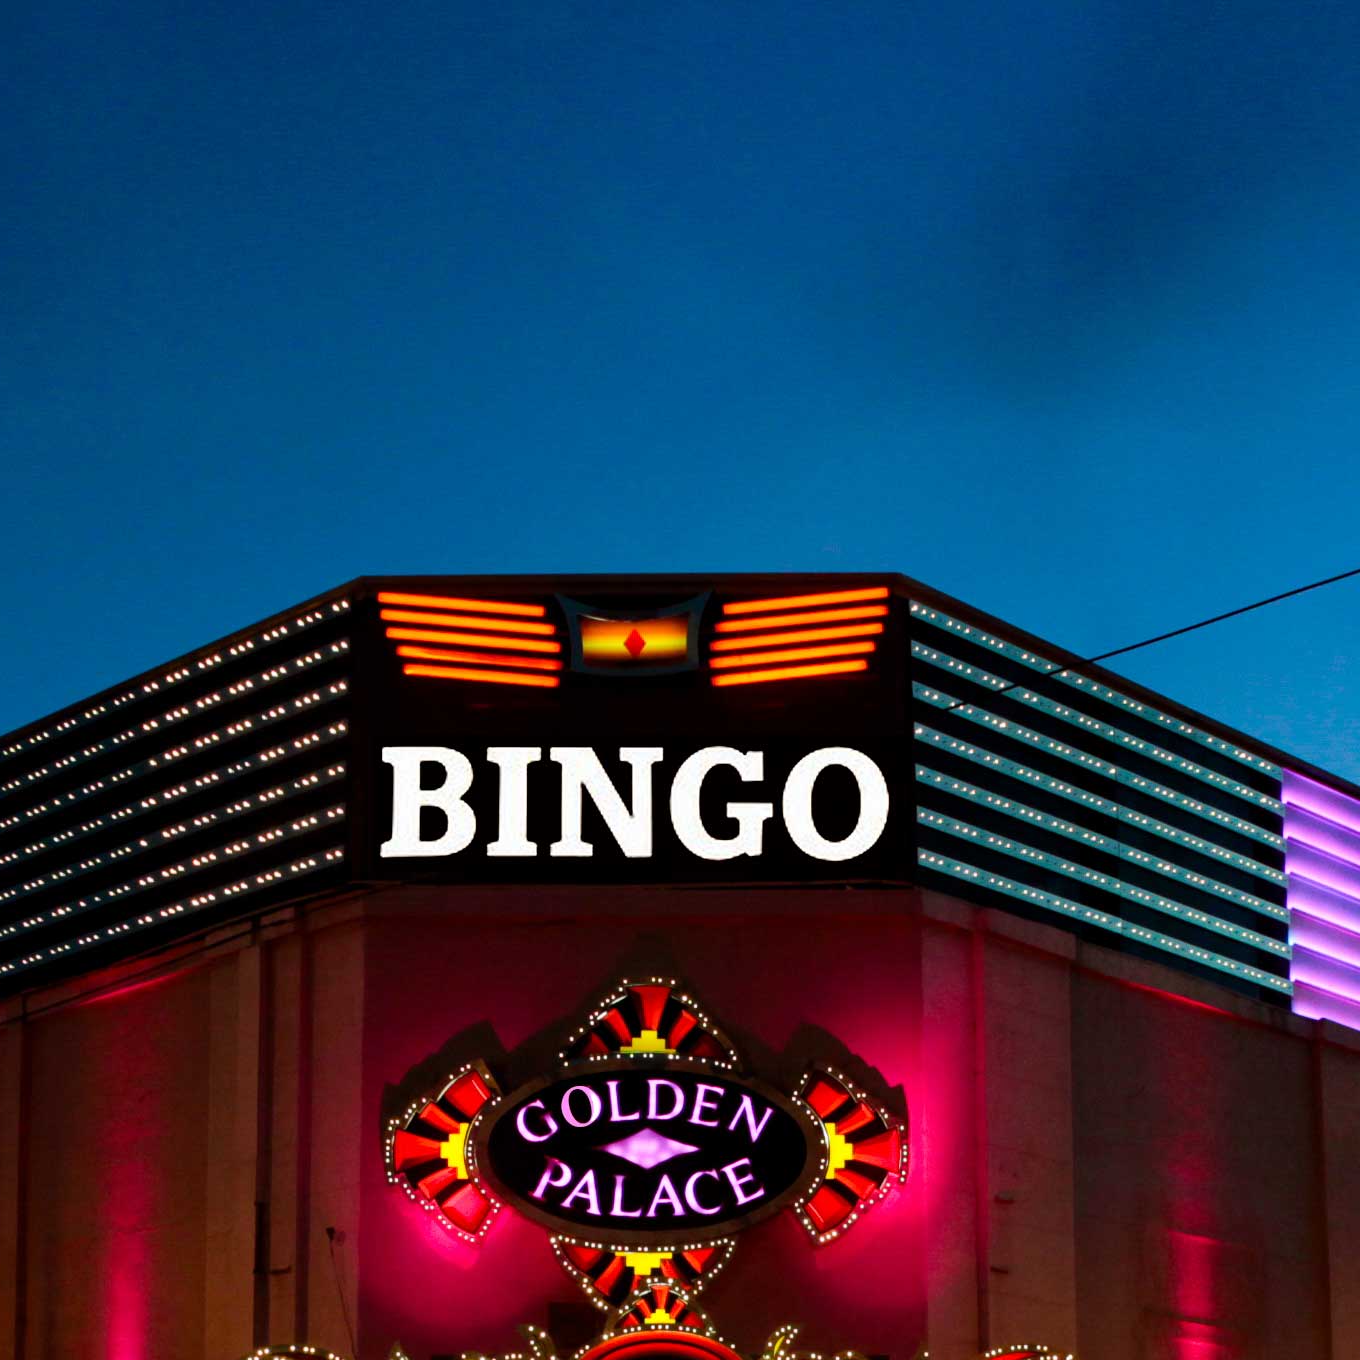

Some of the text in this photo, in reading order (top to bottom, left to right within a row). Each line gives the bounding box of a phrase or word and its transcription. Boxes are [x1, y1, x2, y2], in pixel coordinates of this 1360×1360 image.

[379, 745, 890, 862] BINGO
[515, 1079, 773, 1143] GOLDEN
[529, 1156, 765, 1217] PALACE
